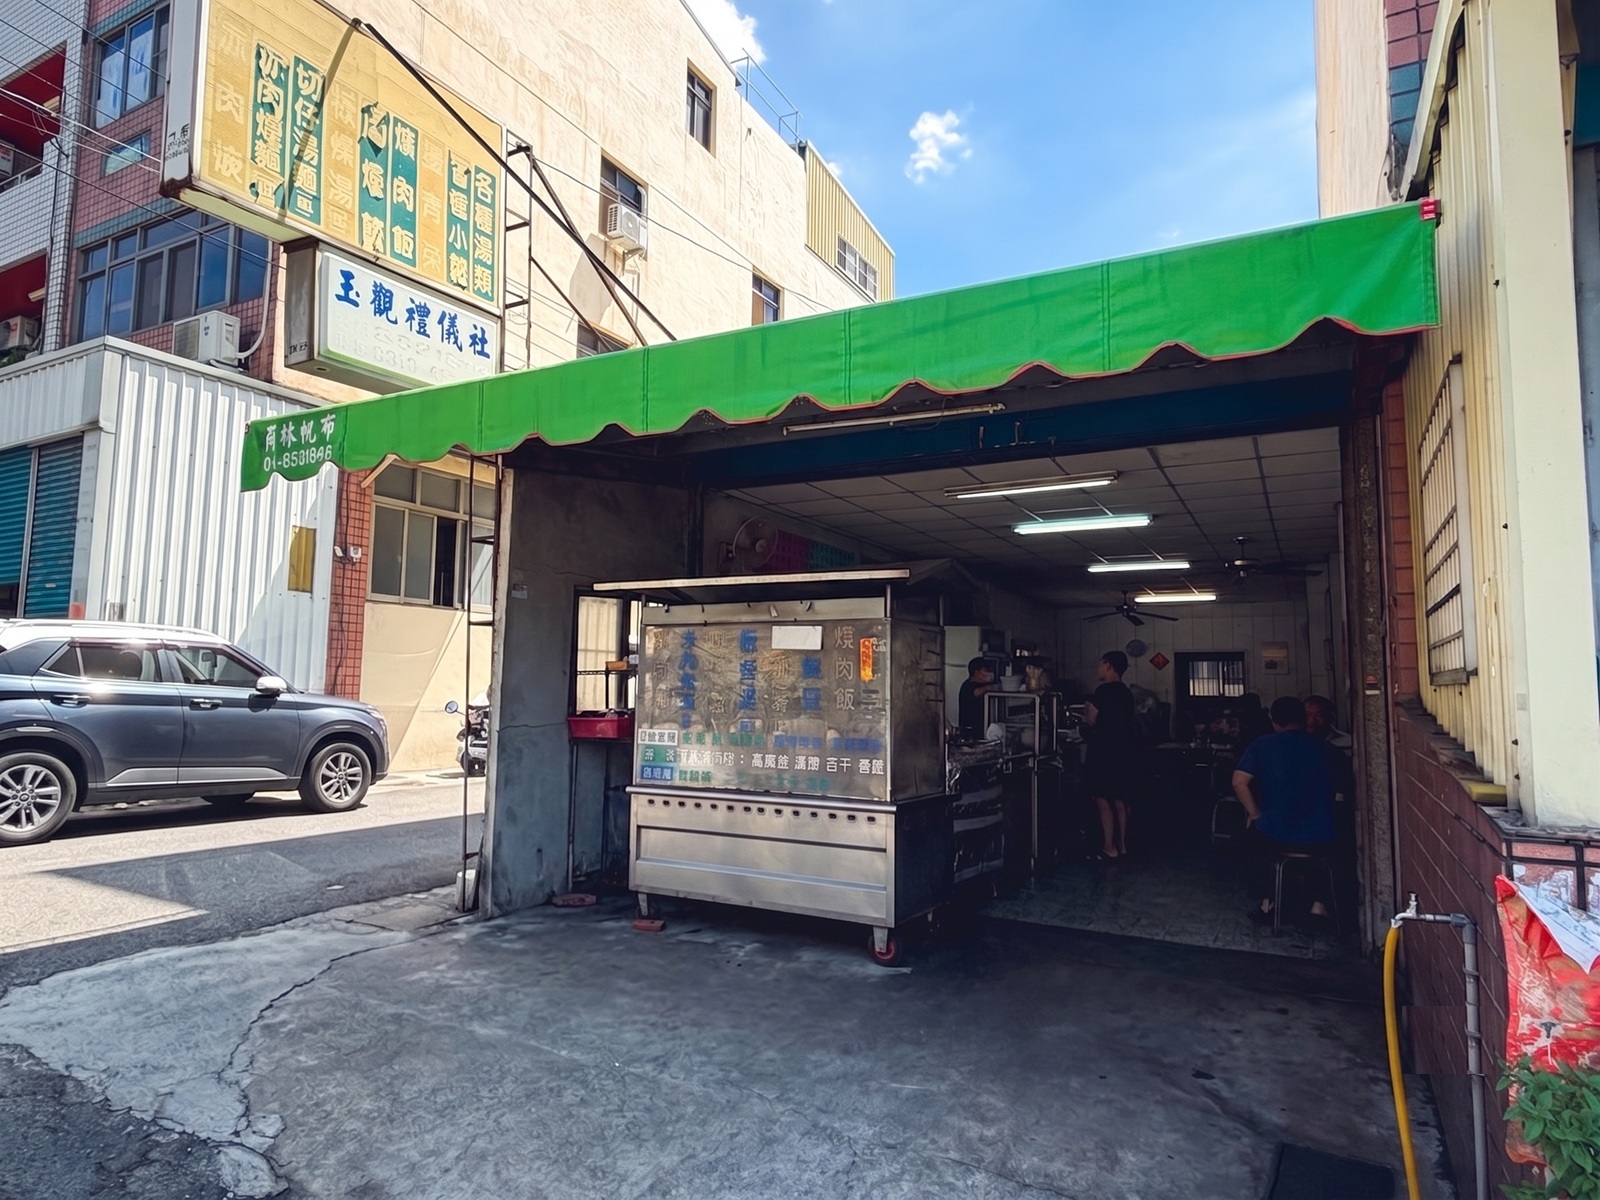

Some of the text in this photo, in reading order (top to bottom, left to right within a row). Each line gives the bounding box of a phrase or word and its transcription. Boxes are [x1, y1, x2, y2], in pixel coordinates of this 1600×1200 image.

[474, 171, 494, 297] 各種湯類
[335, 269, 491, 359] 玉觀禮儀社
